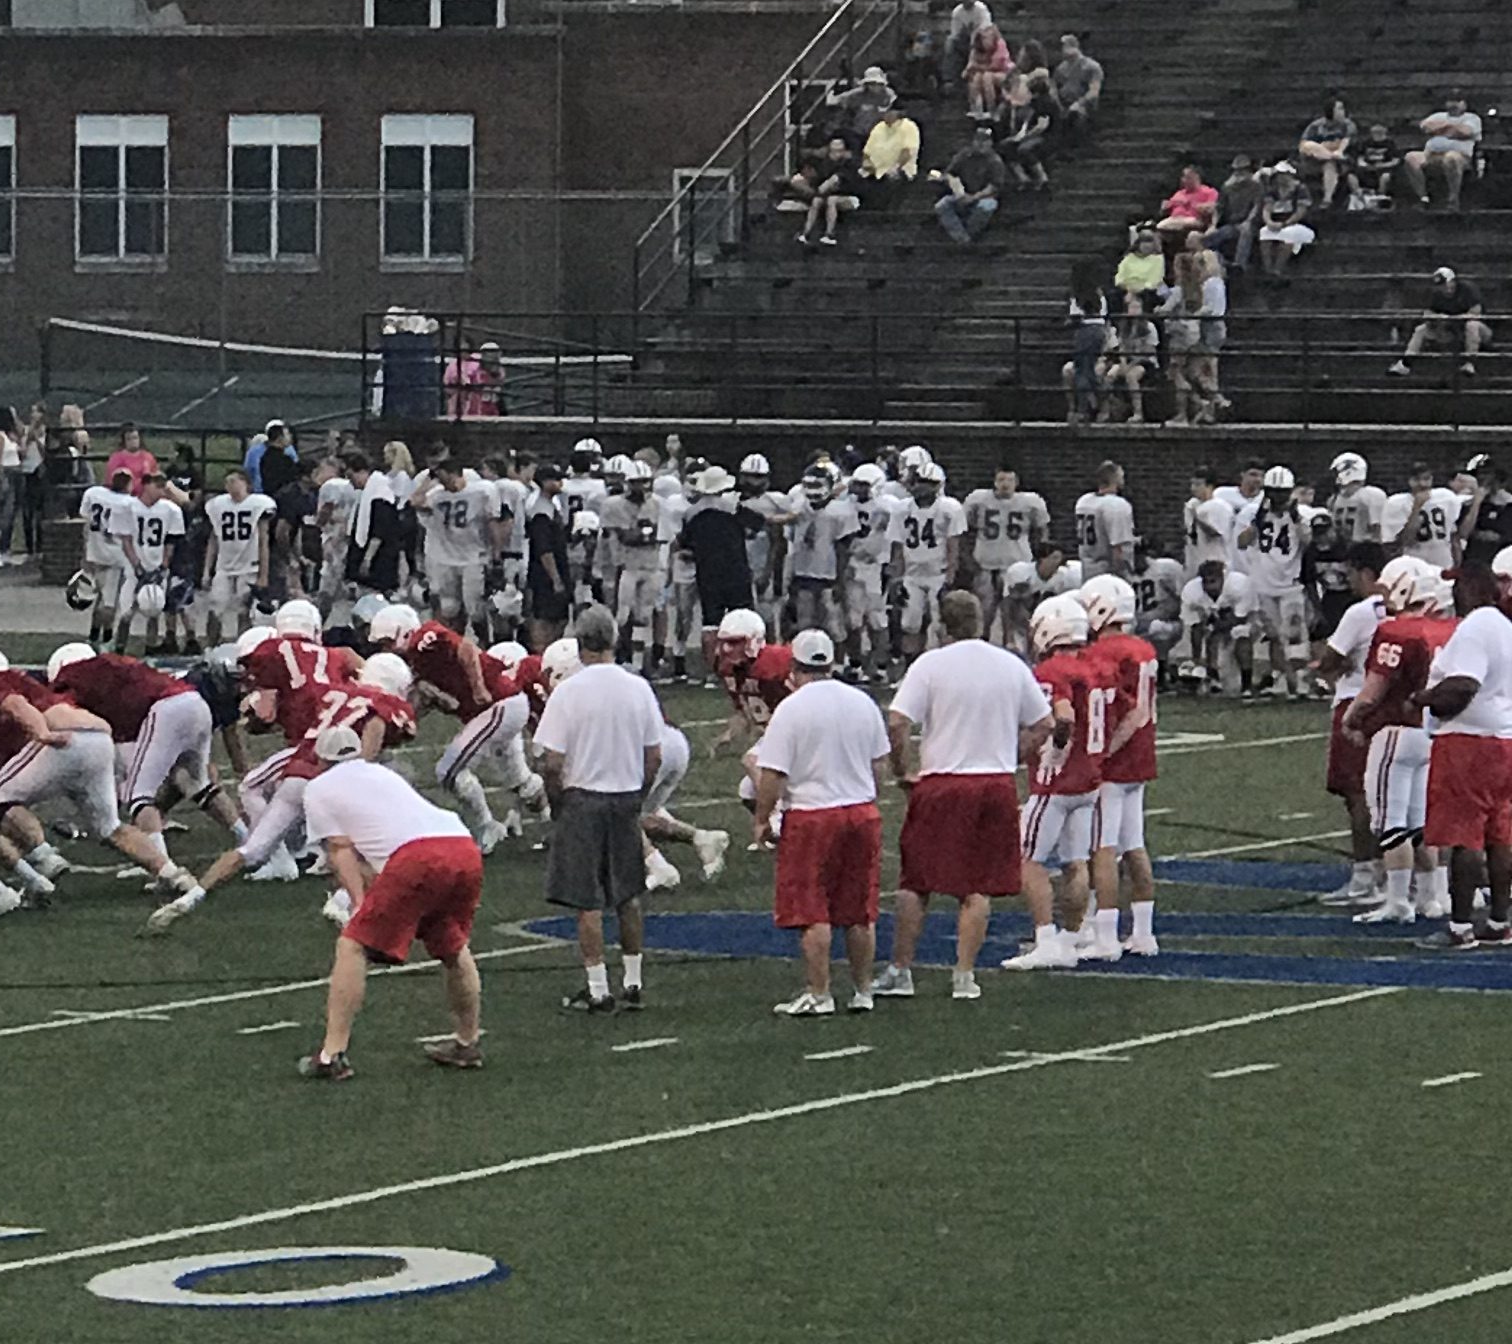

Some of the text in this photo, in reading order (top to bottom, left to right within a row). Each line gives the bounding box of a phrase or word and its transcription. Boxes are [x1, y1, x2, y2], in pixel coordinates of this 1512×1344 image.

[137, 516, 163, 547] 13
[221, 510, 252, 541] 25
[904, 516, 937, 549] 34
[278, 639, 330, 690] 17
